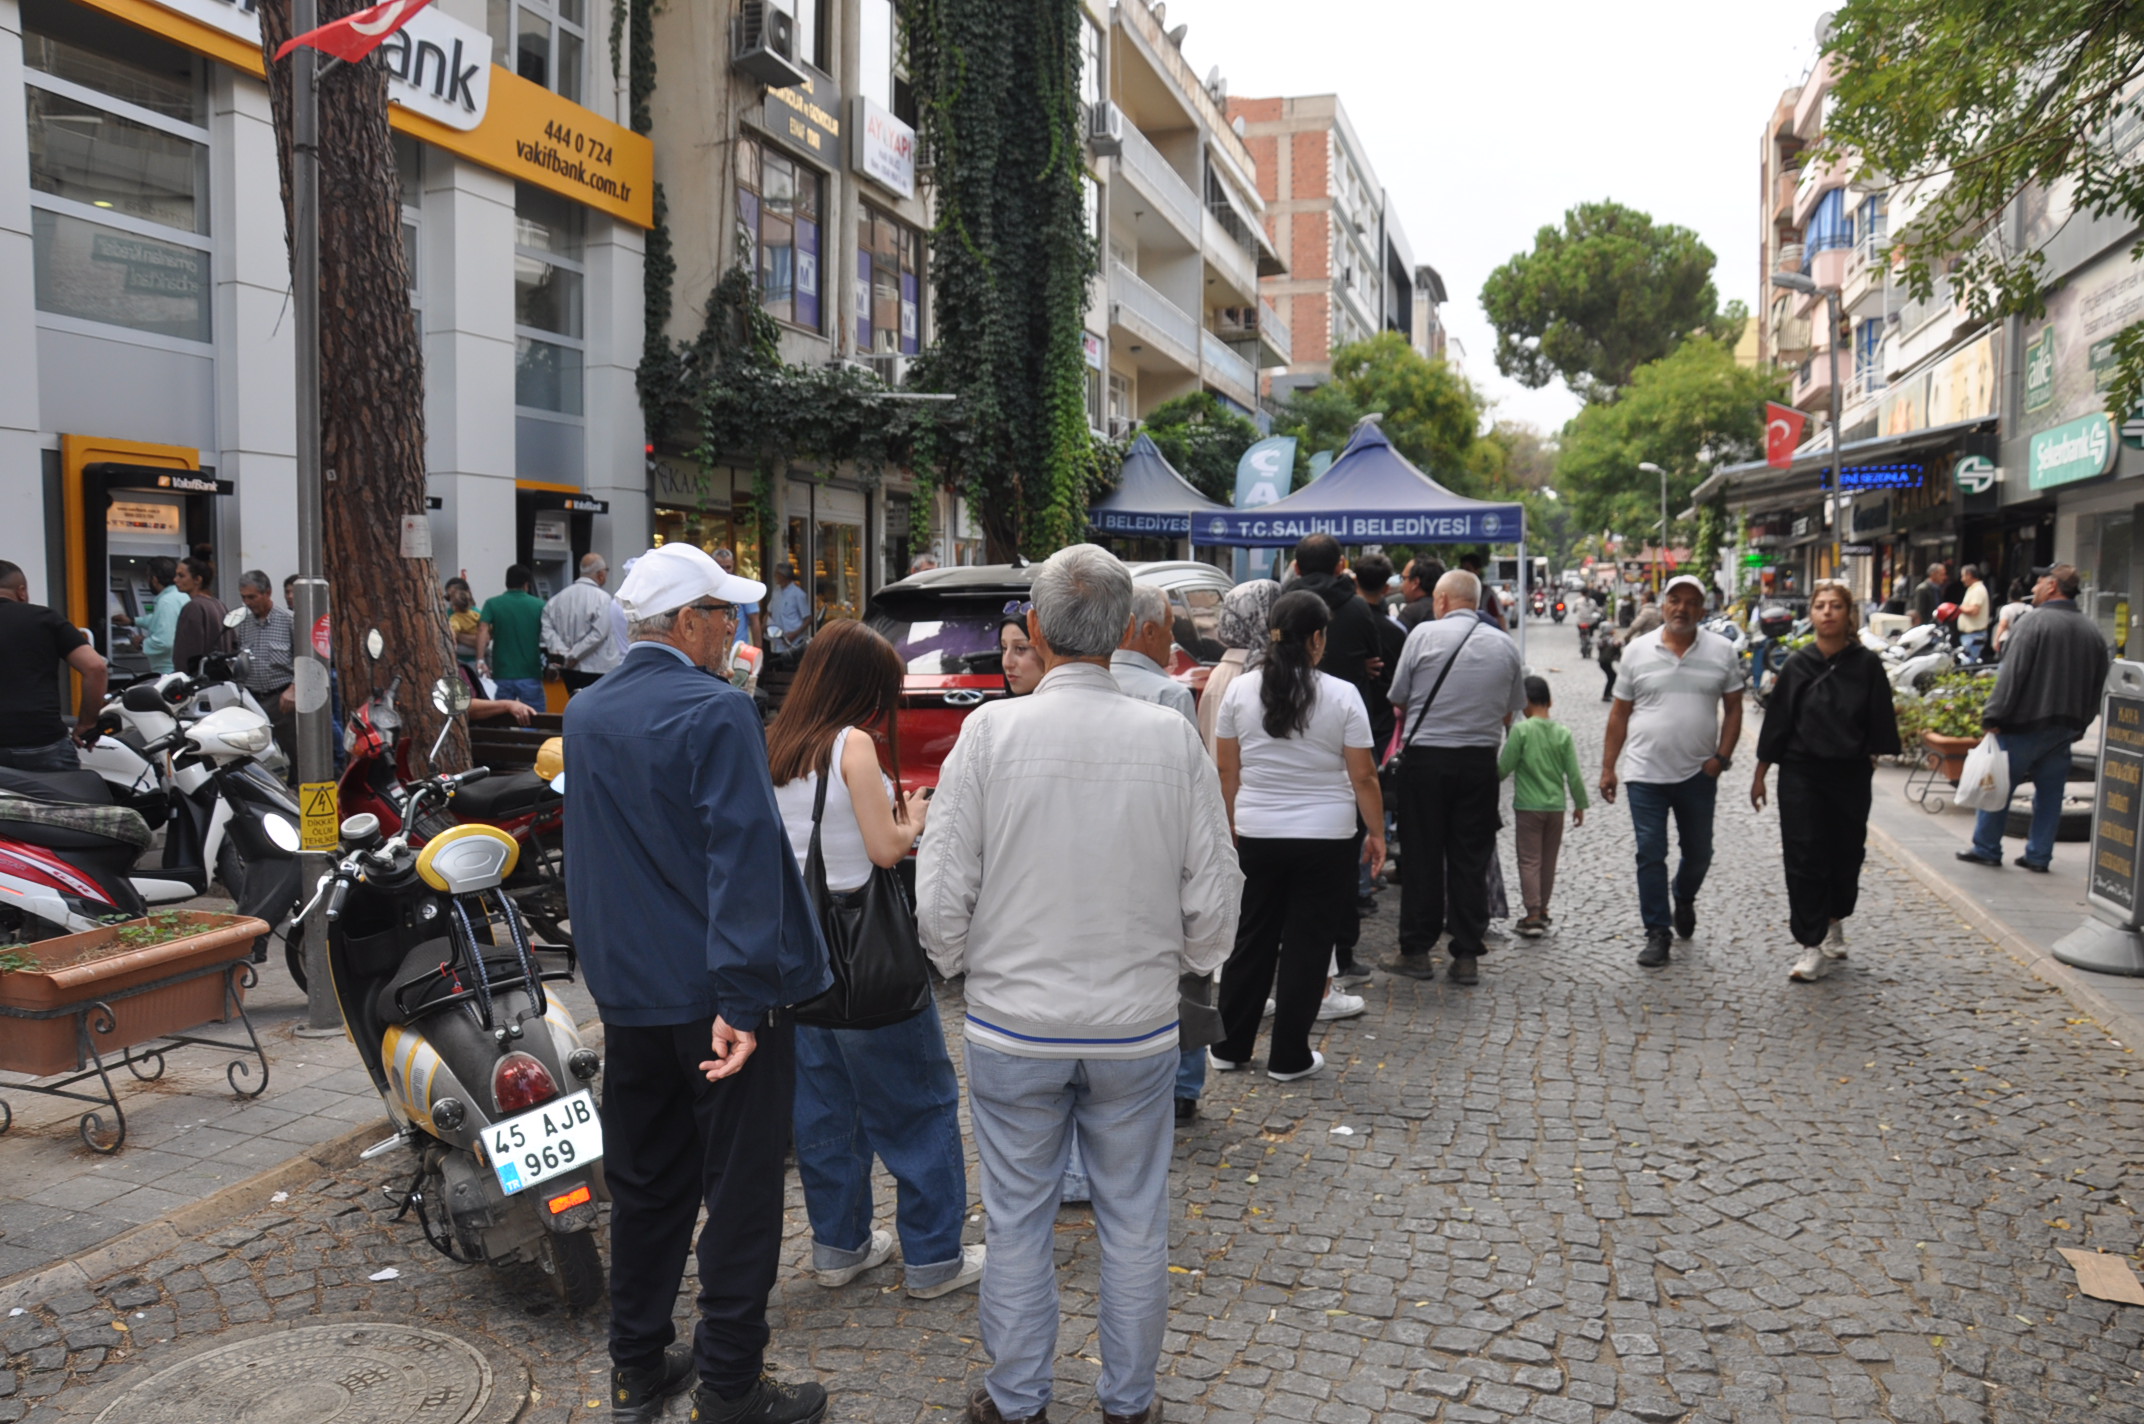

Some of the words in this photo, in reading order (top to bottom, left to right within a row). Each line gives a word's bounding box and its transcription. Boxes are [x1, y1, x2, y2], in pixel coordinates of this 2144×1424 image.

[544, 119, 571, 149] 444
[575, 132, 584, 153] 0
[588, 137, 613, 167] 724
[516, 139, 631, 203] vakifbank.com.tr
[1105, 513, 1190, 533] BELEDİYES
[1352, 514, 1471, 537] BELEDİYESİ
[495, 1123, 526, 1154] 45
[543, 1099, 591, 1138] AJB
[524, 1139, 576, 1177] 969
[506, 1180, 520, 1191] TR
